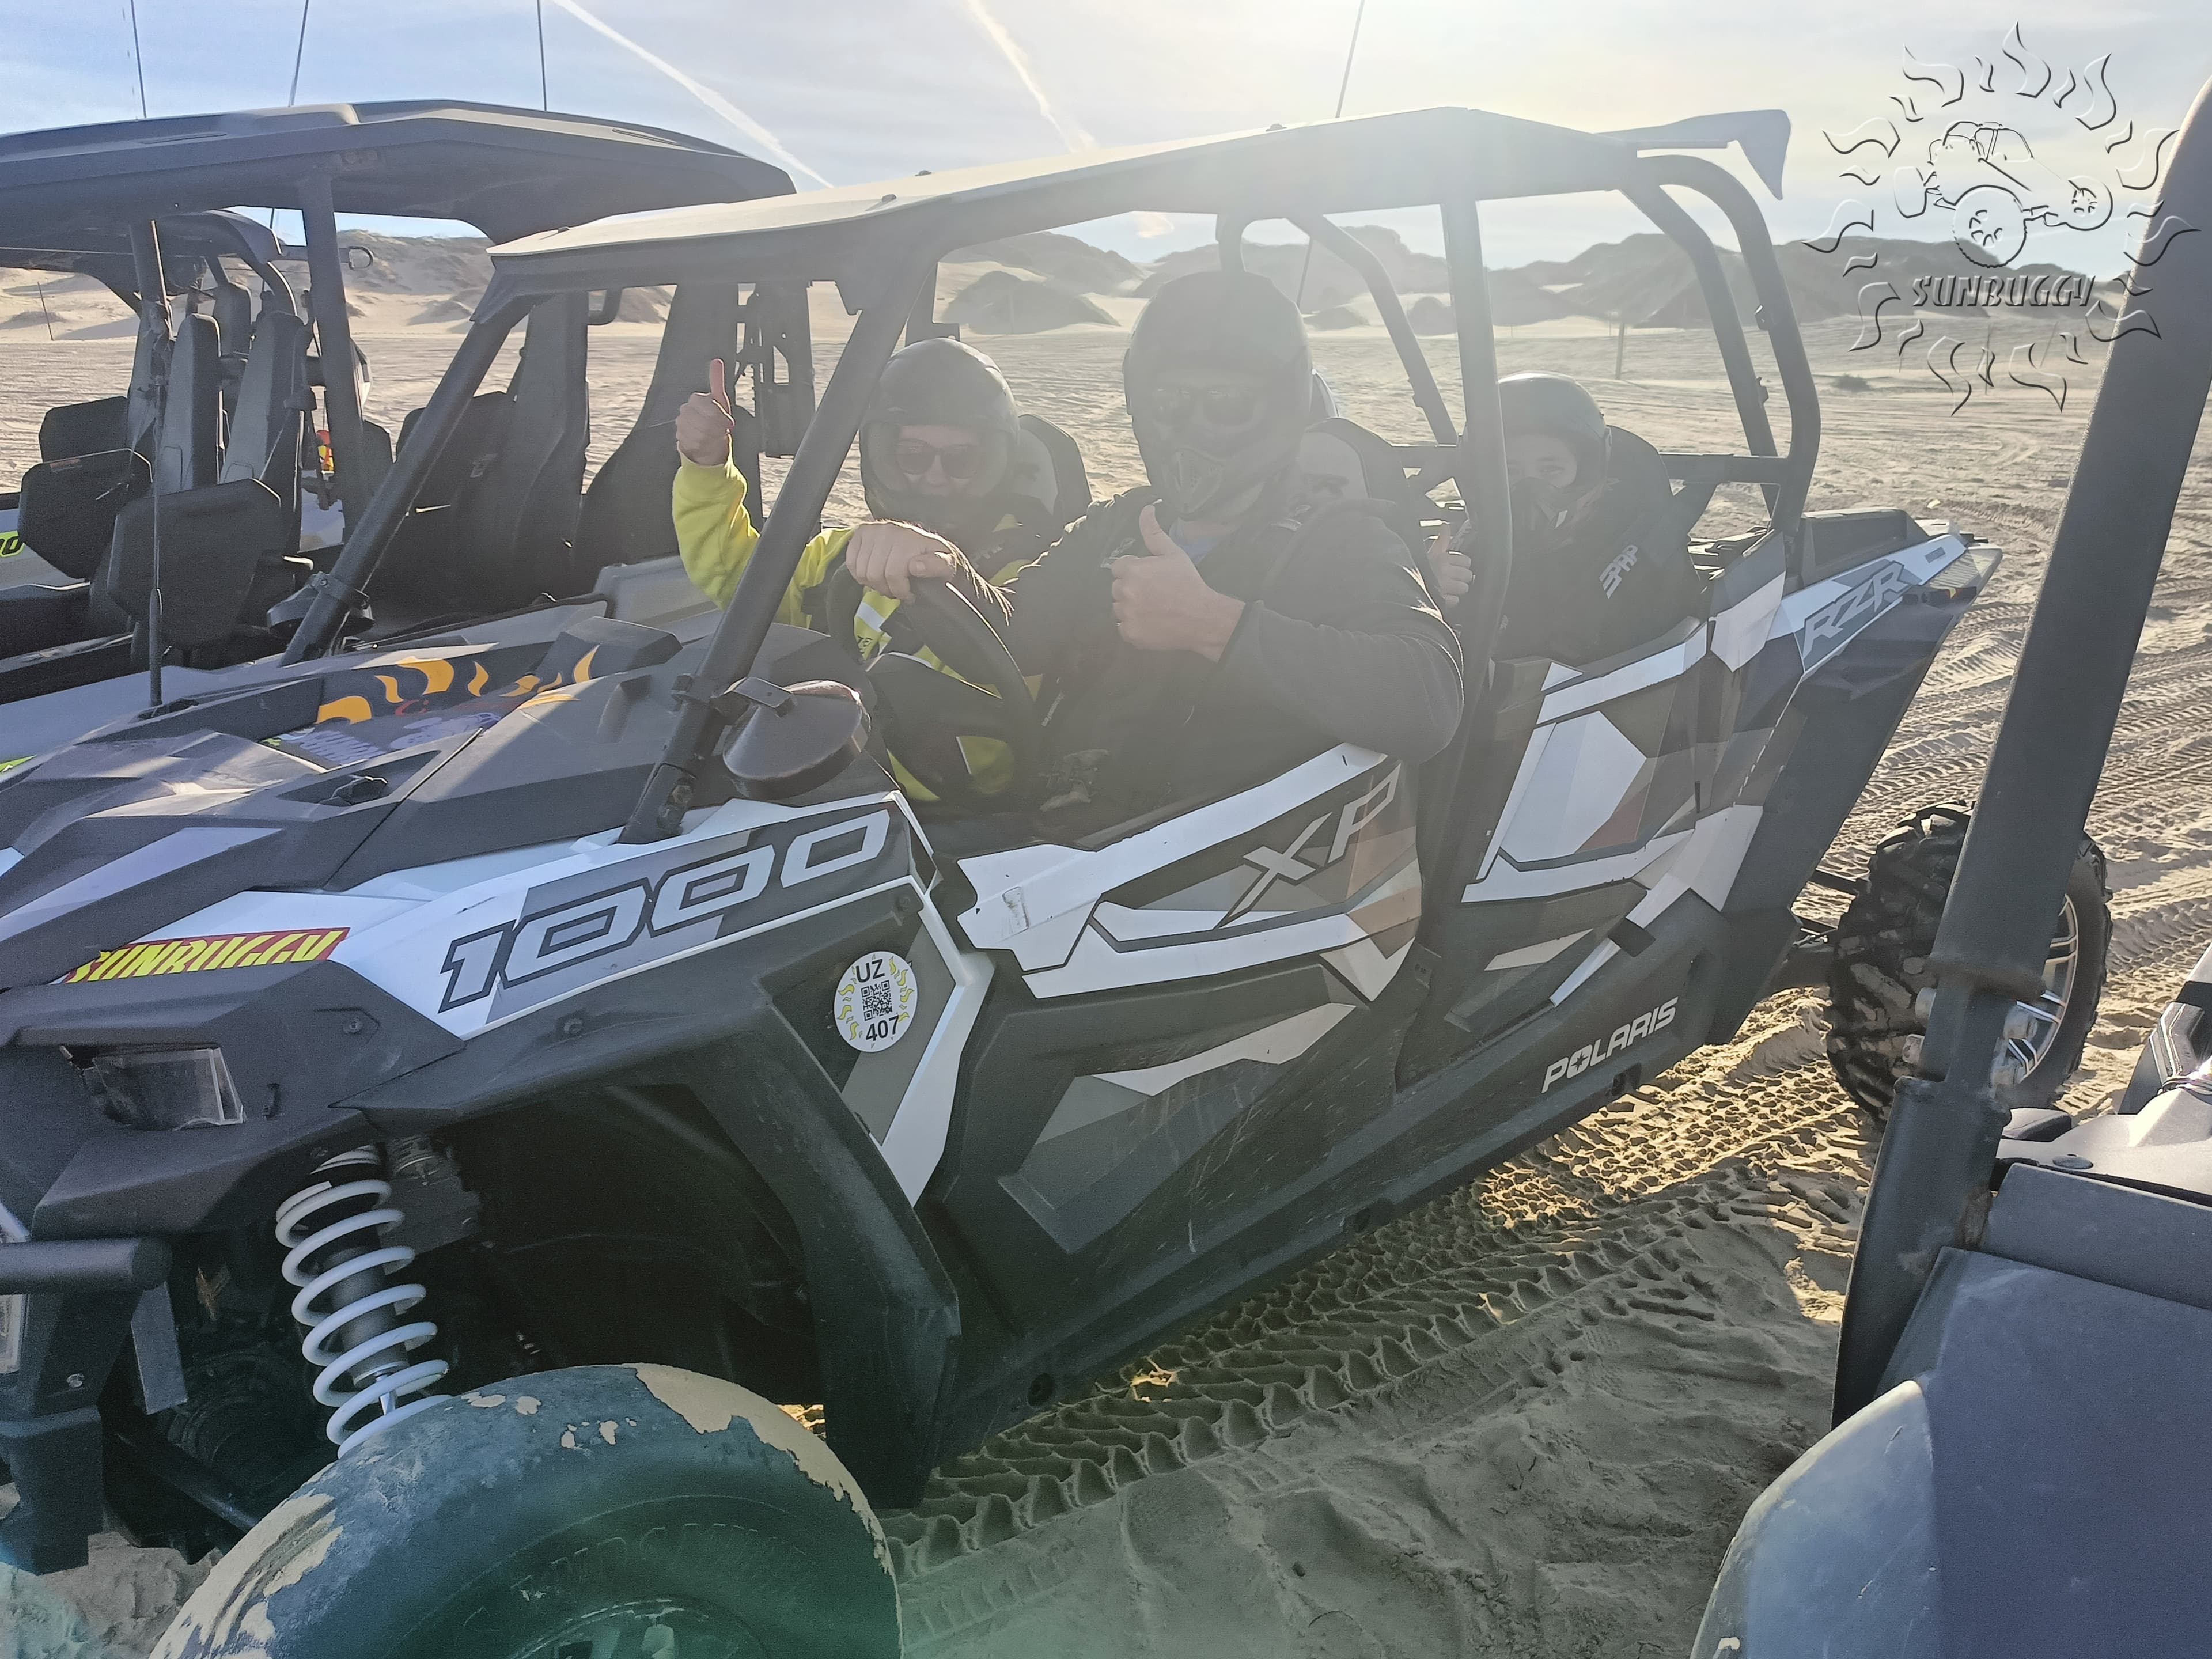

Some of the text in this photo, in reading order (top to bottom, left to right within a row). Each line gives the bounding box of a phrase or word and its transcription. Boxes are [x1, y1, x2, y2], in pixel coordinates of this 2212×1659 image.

[1802, 560, 1908, 660] RZR
[1228, 763, 1402, 918] XP
[66, 930, 345, 983] SUNBUGGY
[439, 809, 891, 1013] 1000
[856, 959, 885, 983] UZ
[866, 1015, 899, 1041] 407
[1541, 996, 1679, 1094] POLARIS
